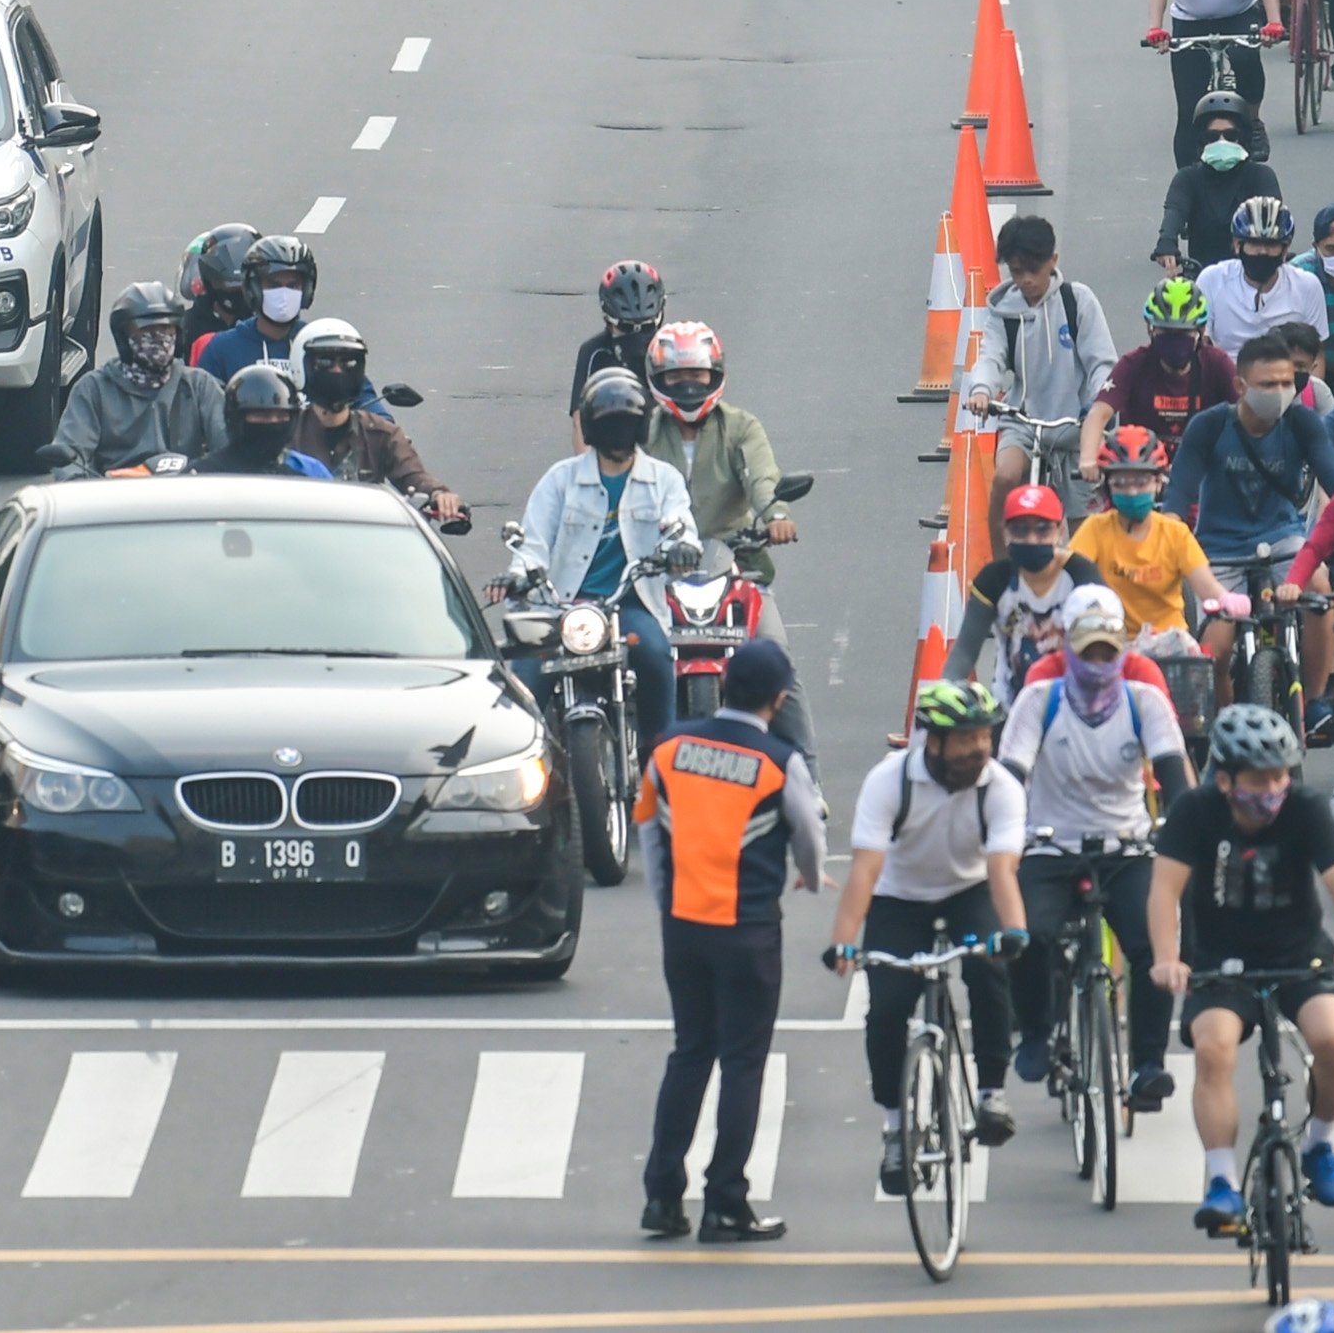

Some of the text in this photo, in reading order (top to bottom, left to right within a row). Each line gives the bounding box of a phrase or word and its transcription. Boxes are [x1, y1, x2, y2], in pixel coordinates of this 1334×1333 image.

[156, 457, 185, 471] 93
[674, 742, 760, 786] DISHUB
[221, 840, 236, 868] B
[264, 840, 315, 868] 1396
